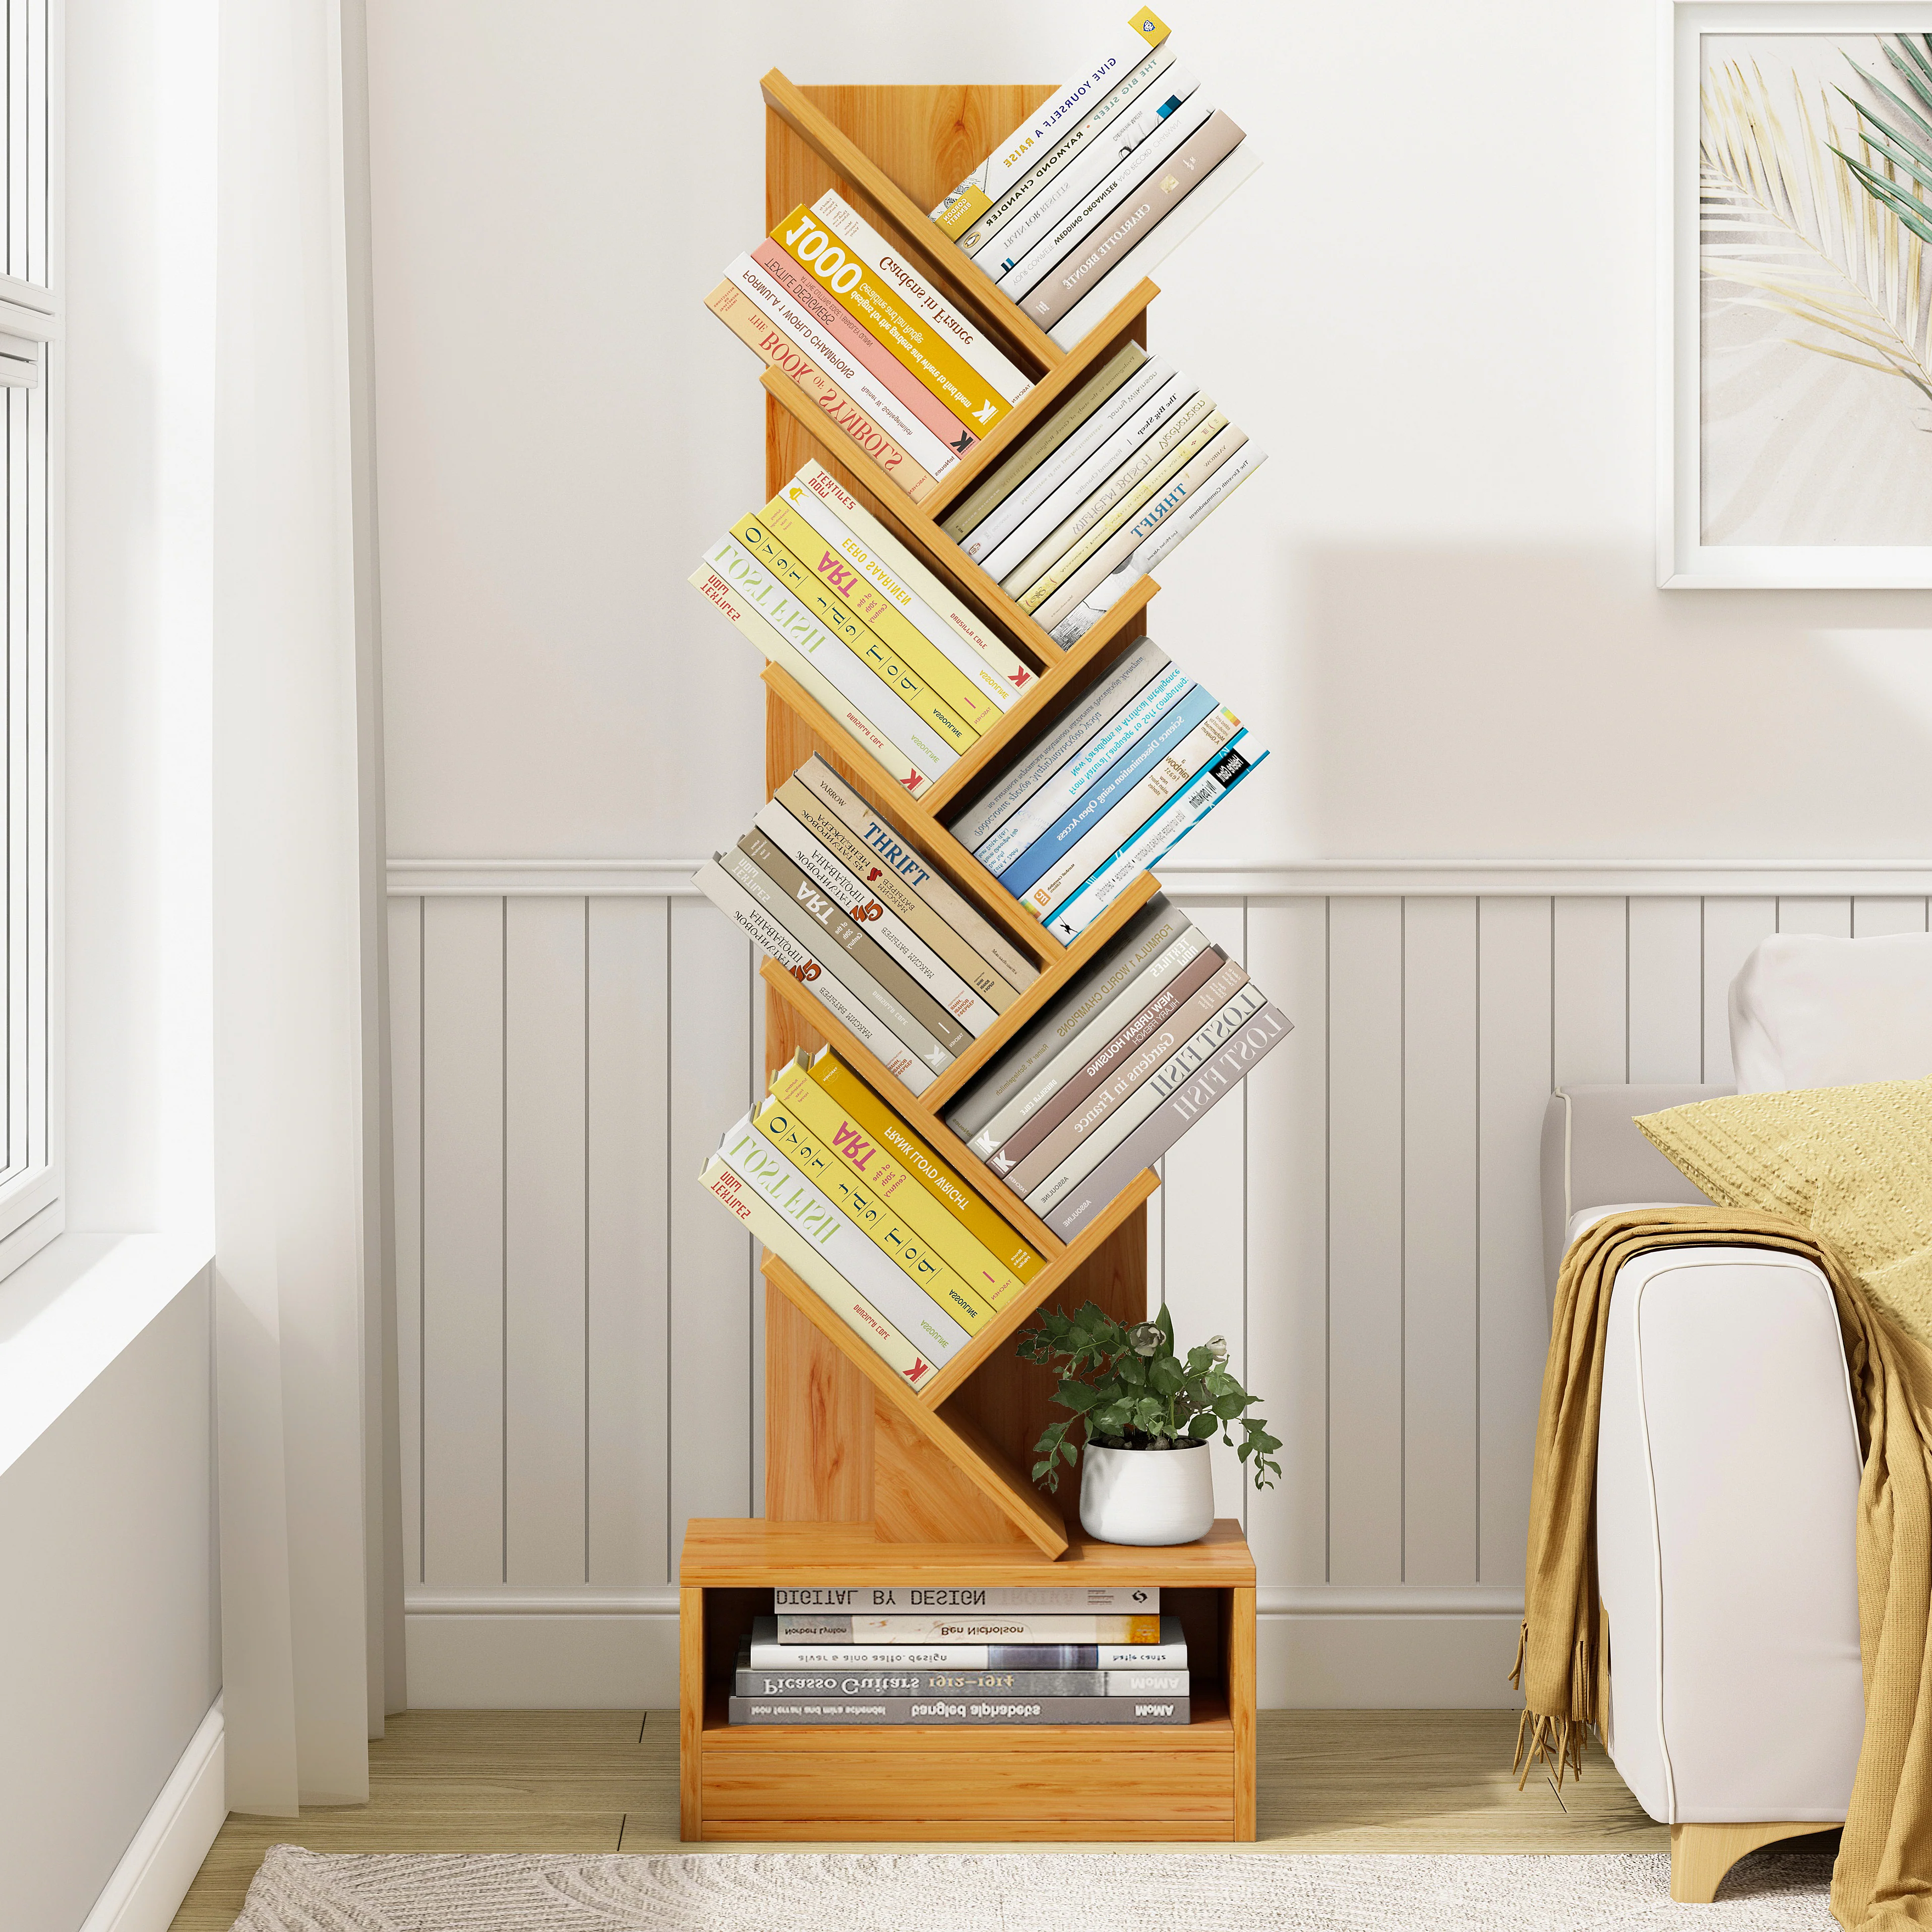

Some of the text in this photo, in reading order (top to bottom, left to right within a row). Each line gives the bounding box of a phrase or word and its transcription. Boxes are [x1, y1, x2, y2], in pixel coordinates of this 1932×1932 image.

[820, 780, 847, 806] YARROW
[801, 809, 864, 871] 45 ТАТУИРОВОК
[817, 814, 871, 867] МЕНЕДЖЕРА
[863, 821, 930, 886] THRIFT
[795, 851, 852, 908] ТАТУИРОВОК
[811, 849, 865, 903] ПРОДАВАНА
[881, 927, 935, 979] МАКСИМ БАТЫРЕВ
